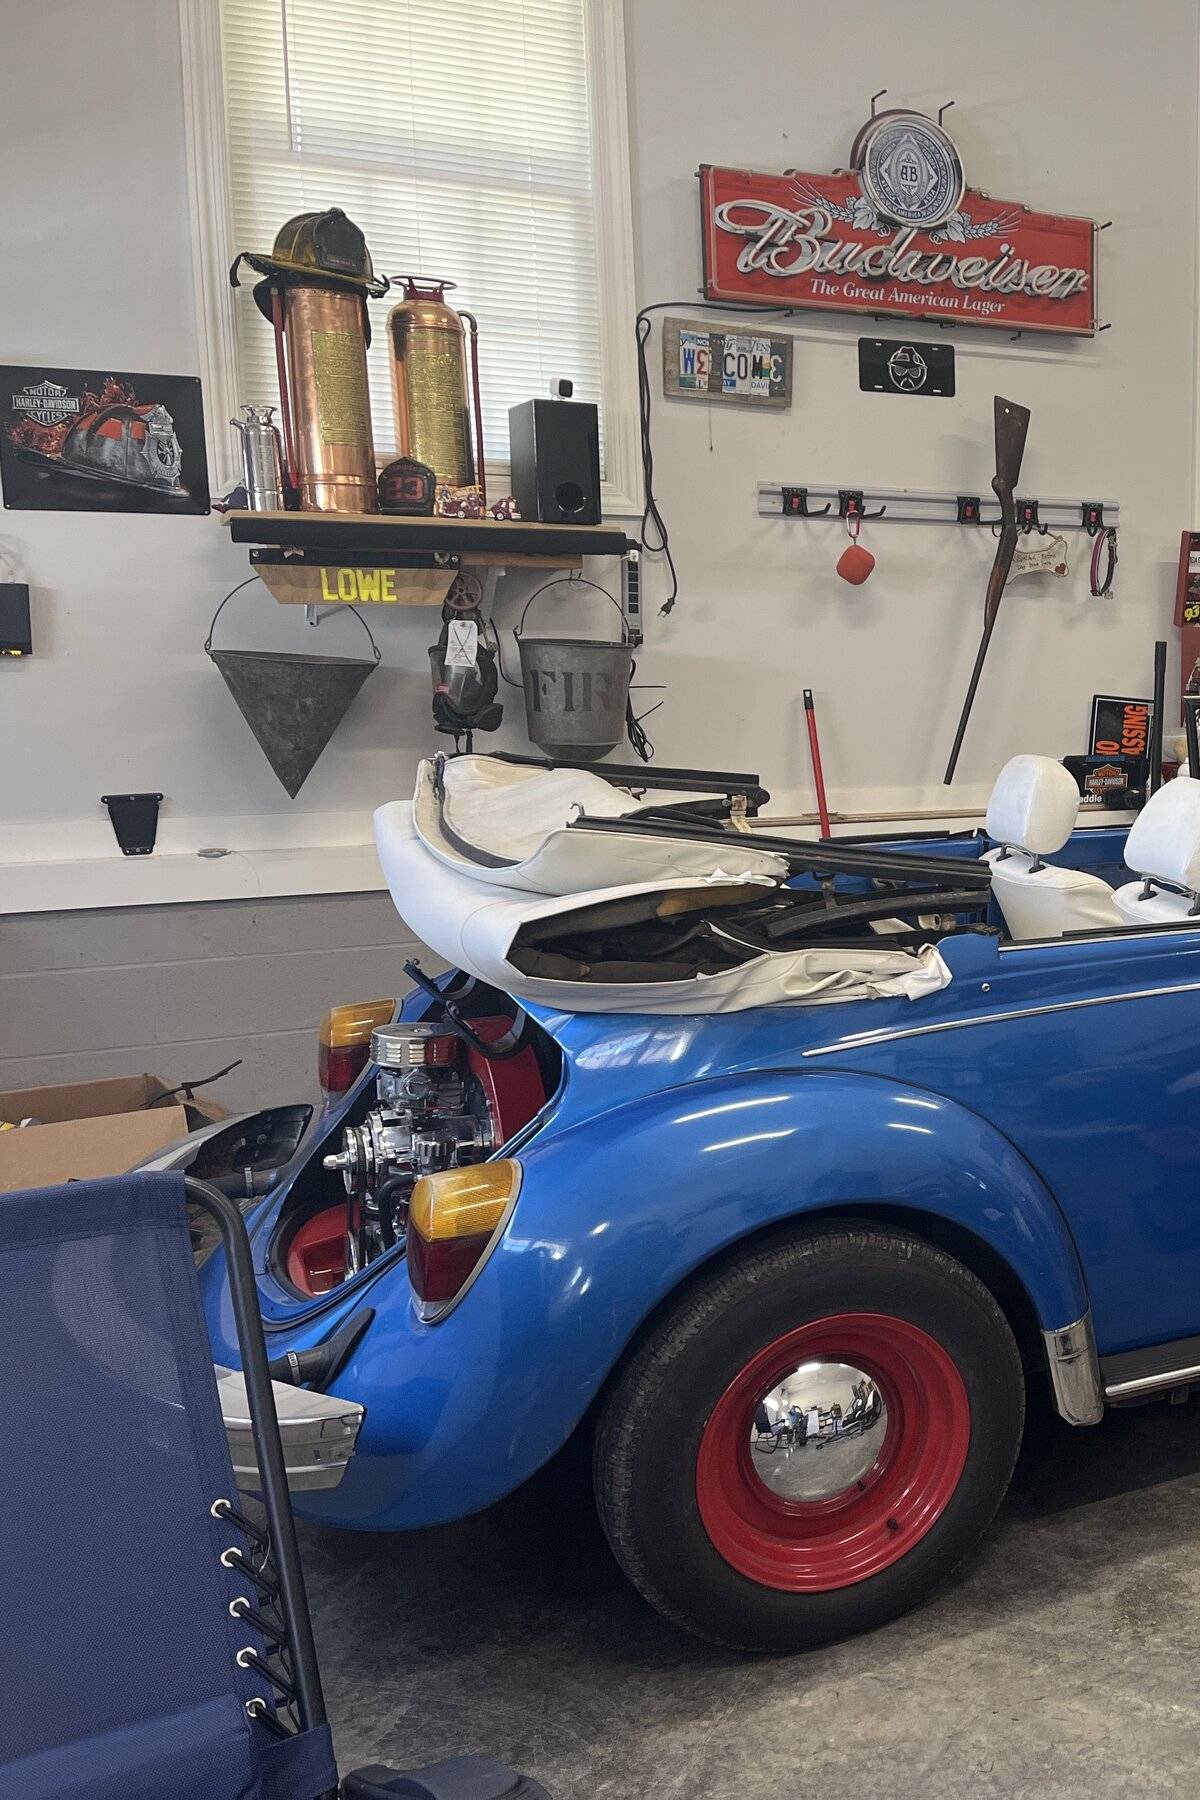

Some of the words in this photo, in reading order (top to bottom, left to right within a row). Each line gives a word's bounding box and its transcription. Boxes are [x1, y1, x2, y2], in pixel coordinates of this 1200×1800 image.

[714, 199, 1090, 300] Budweiser
[811, 278, 839, 295] The
[843, 282, 885, 300] Great
[888, 288, 959, 308] American
[962, 296, 1005, 315] Lager
[16, 397, 76, 410] HARLEY-DAVIDSON
[29, 385, 62, 398] MOTOR
[31, 410, 63, 424] CYCLES
[320, 568, 397, 602] LOWE
